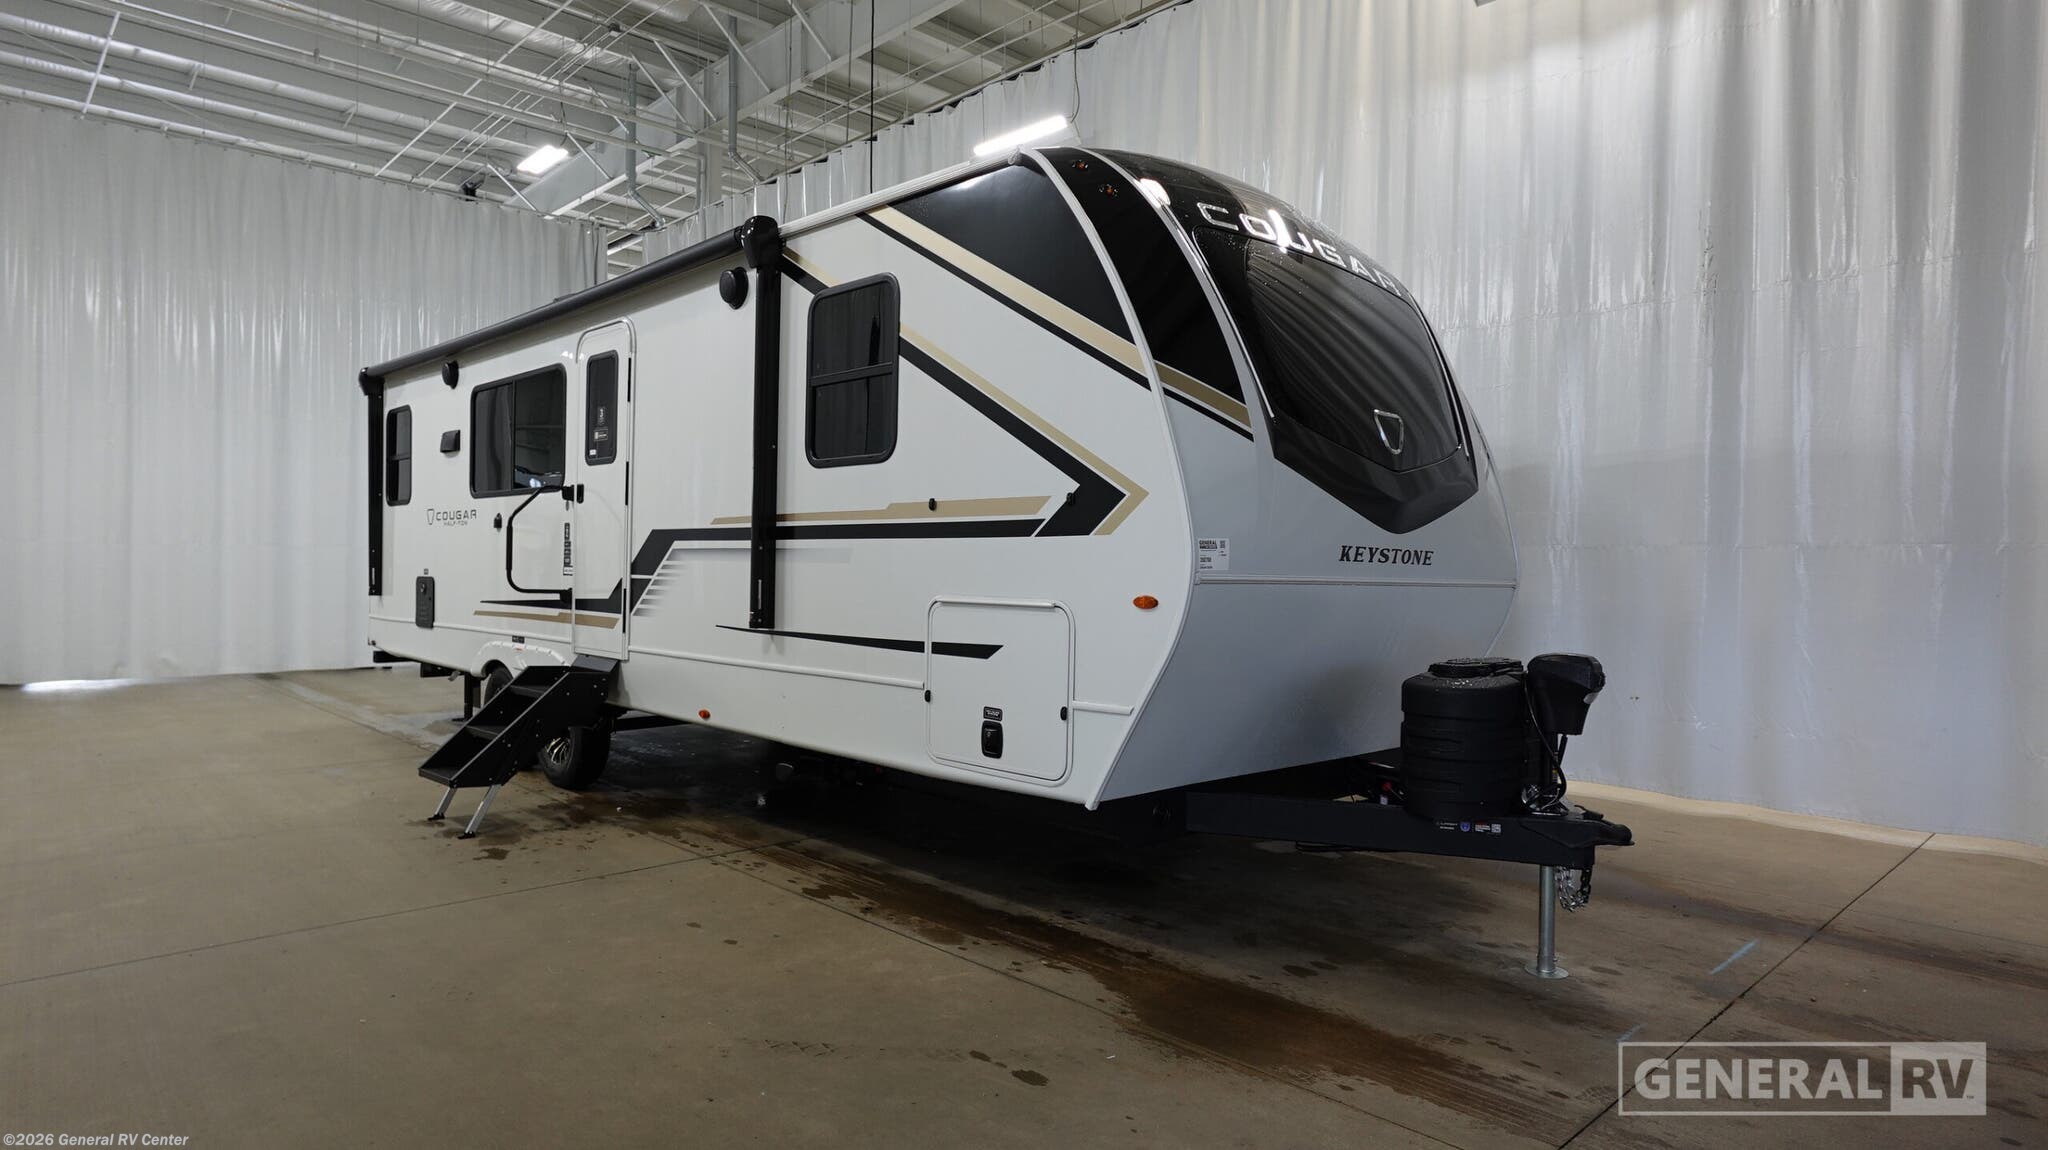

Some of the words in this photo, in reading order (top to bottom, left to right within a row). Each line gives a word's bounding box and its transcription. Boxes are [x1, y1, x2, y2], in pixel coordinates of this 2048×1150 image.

[1197, 202, 1402, 297] COUGAR
[436, 509, 477, 521] COUGAR
[1339, 545, 1434, 566] KEYSTONE
